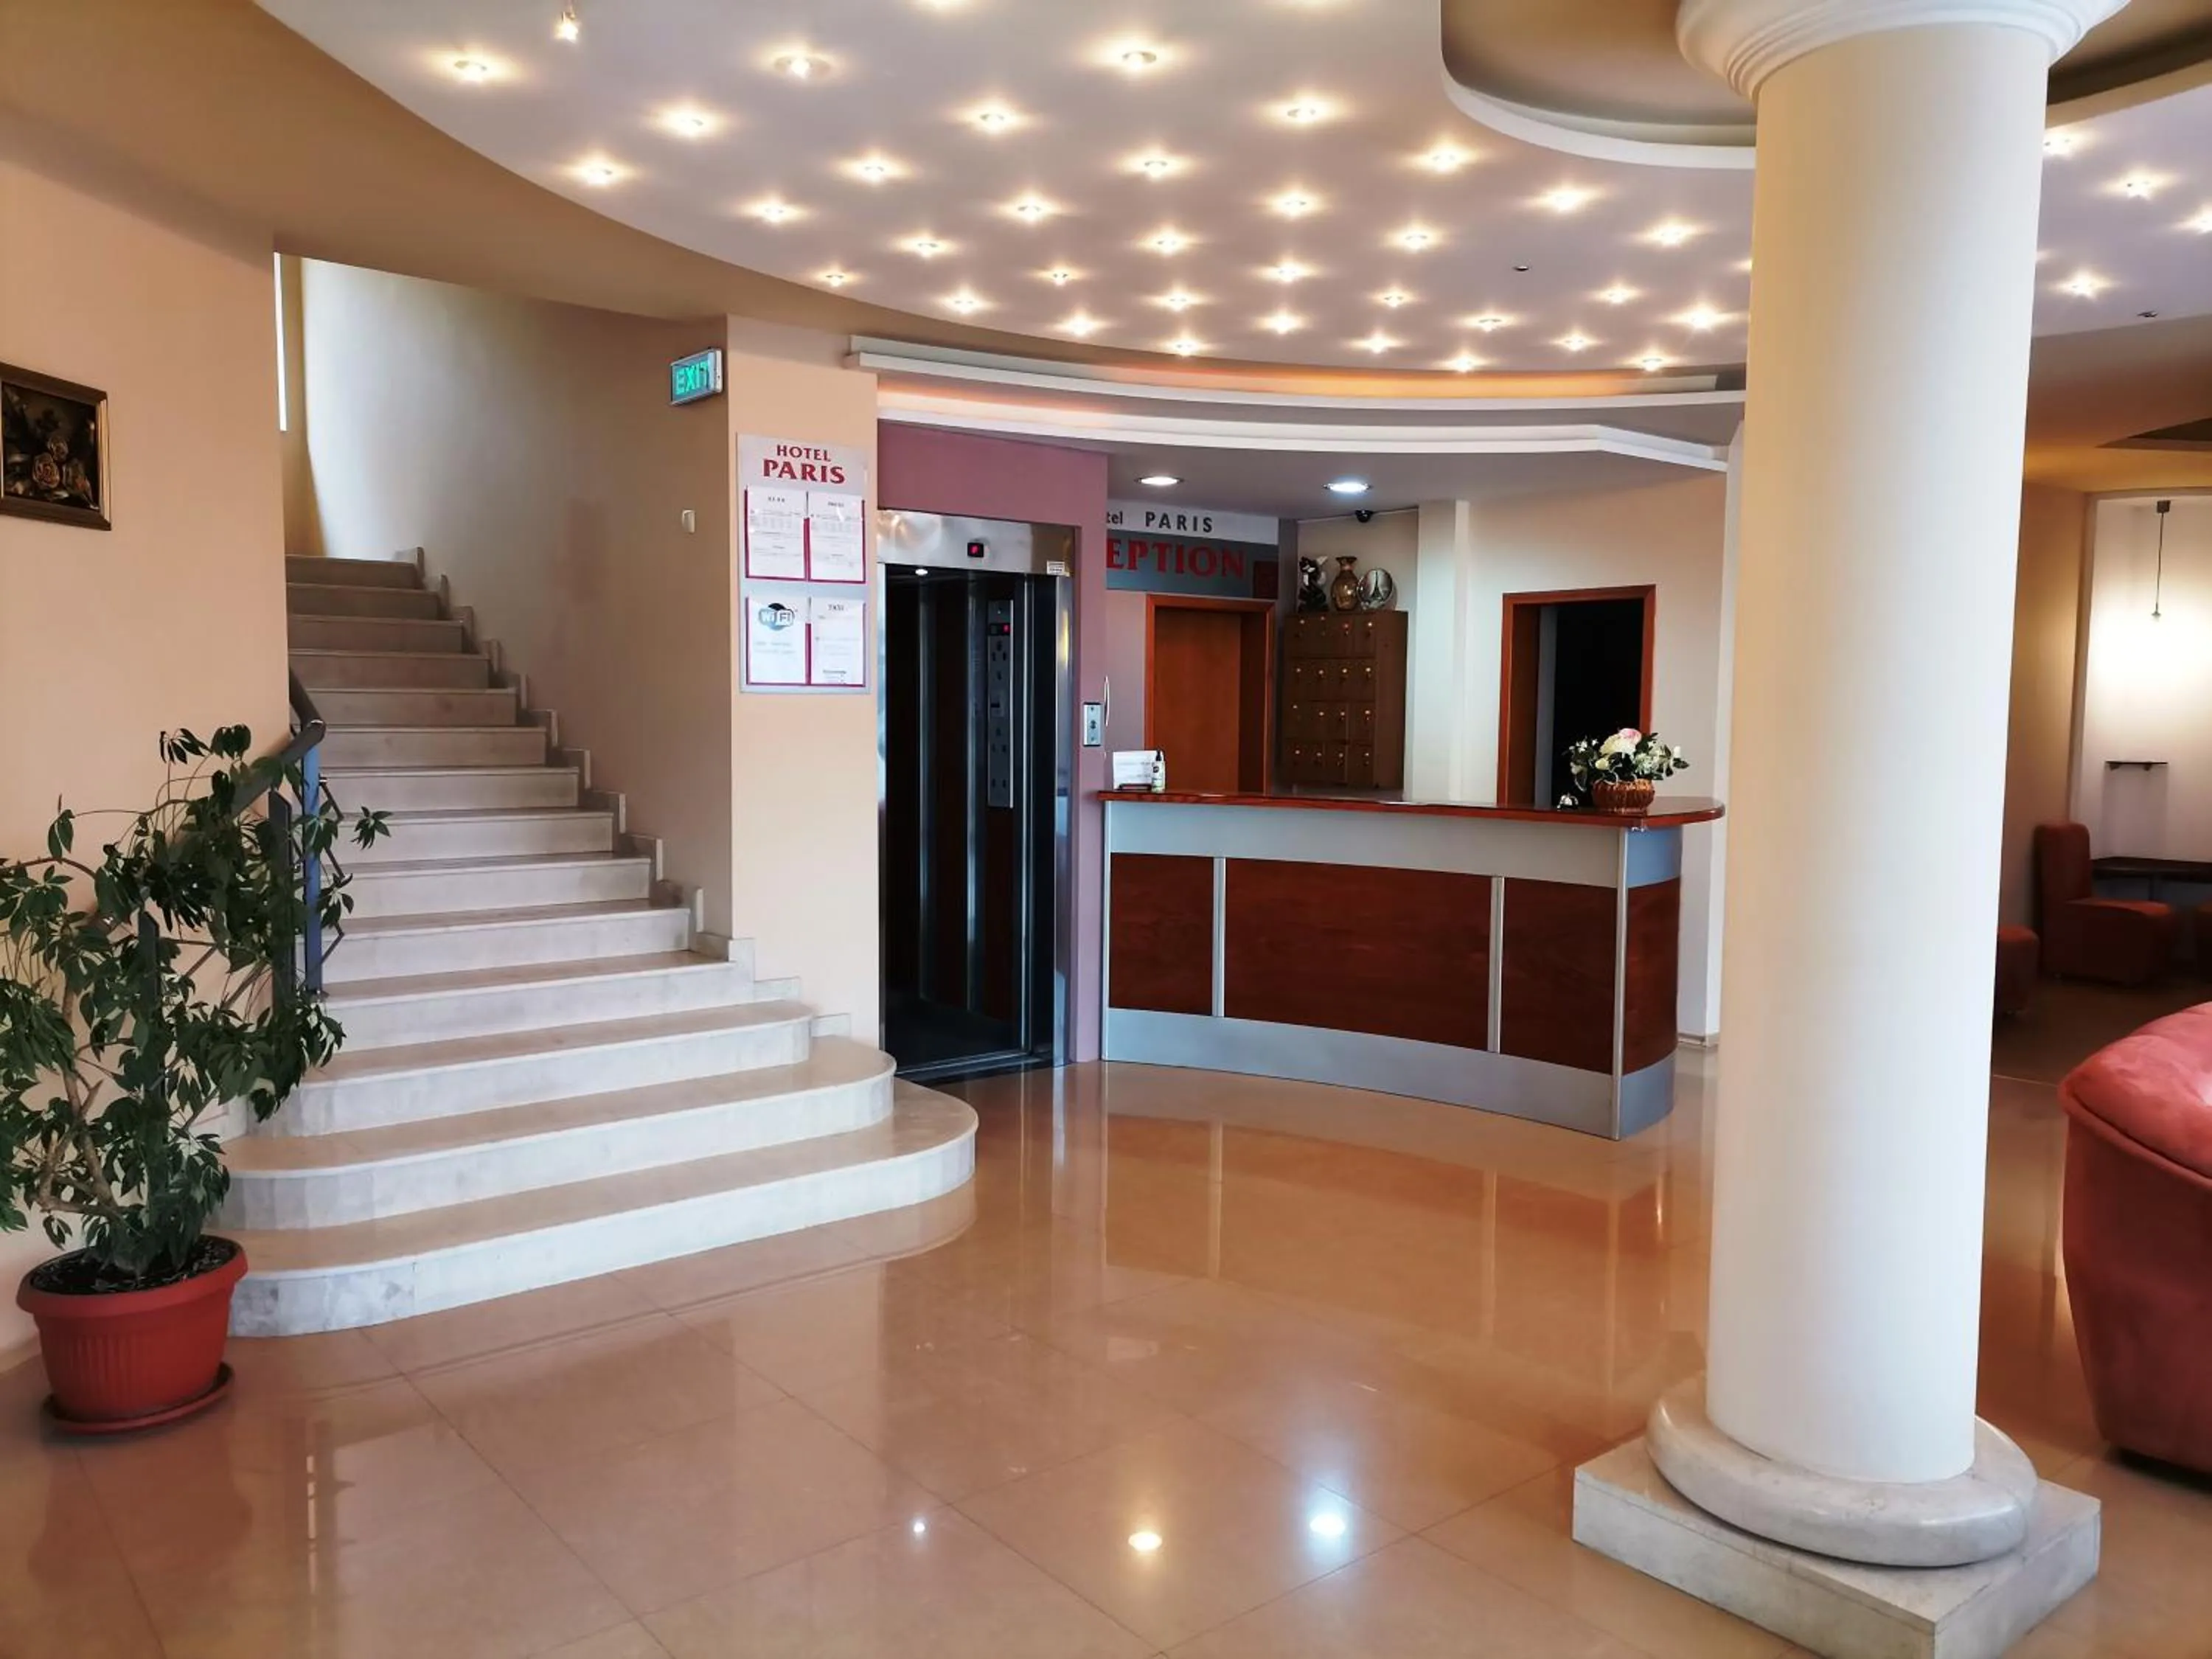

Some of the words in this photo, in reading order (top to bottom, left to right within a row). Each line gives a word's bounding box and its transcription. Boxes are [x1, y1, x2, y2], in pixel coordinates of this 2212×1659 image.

[675, 361, 709, 395] EXIT
[776, 445, 831, 462] HOTEL
[762, 459, 846, 484] PARIS
[1107, 511, 1123, 525] tel
[1145, 511, 1214, 533] PARIS
[1107, 537, 1246, 579] EPTION
